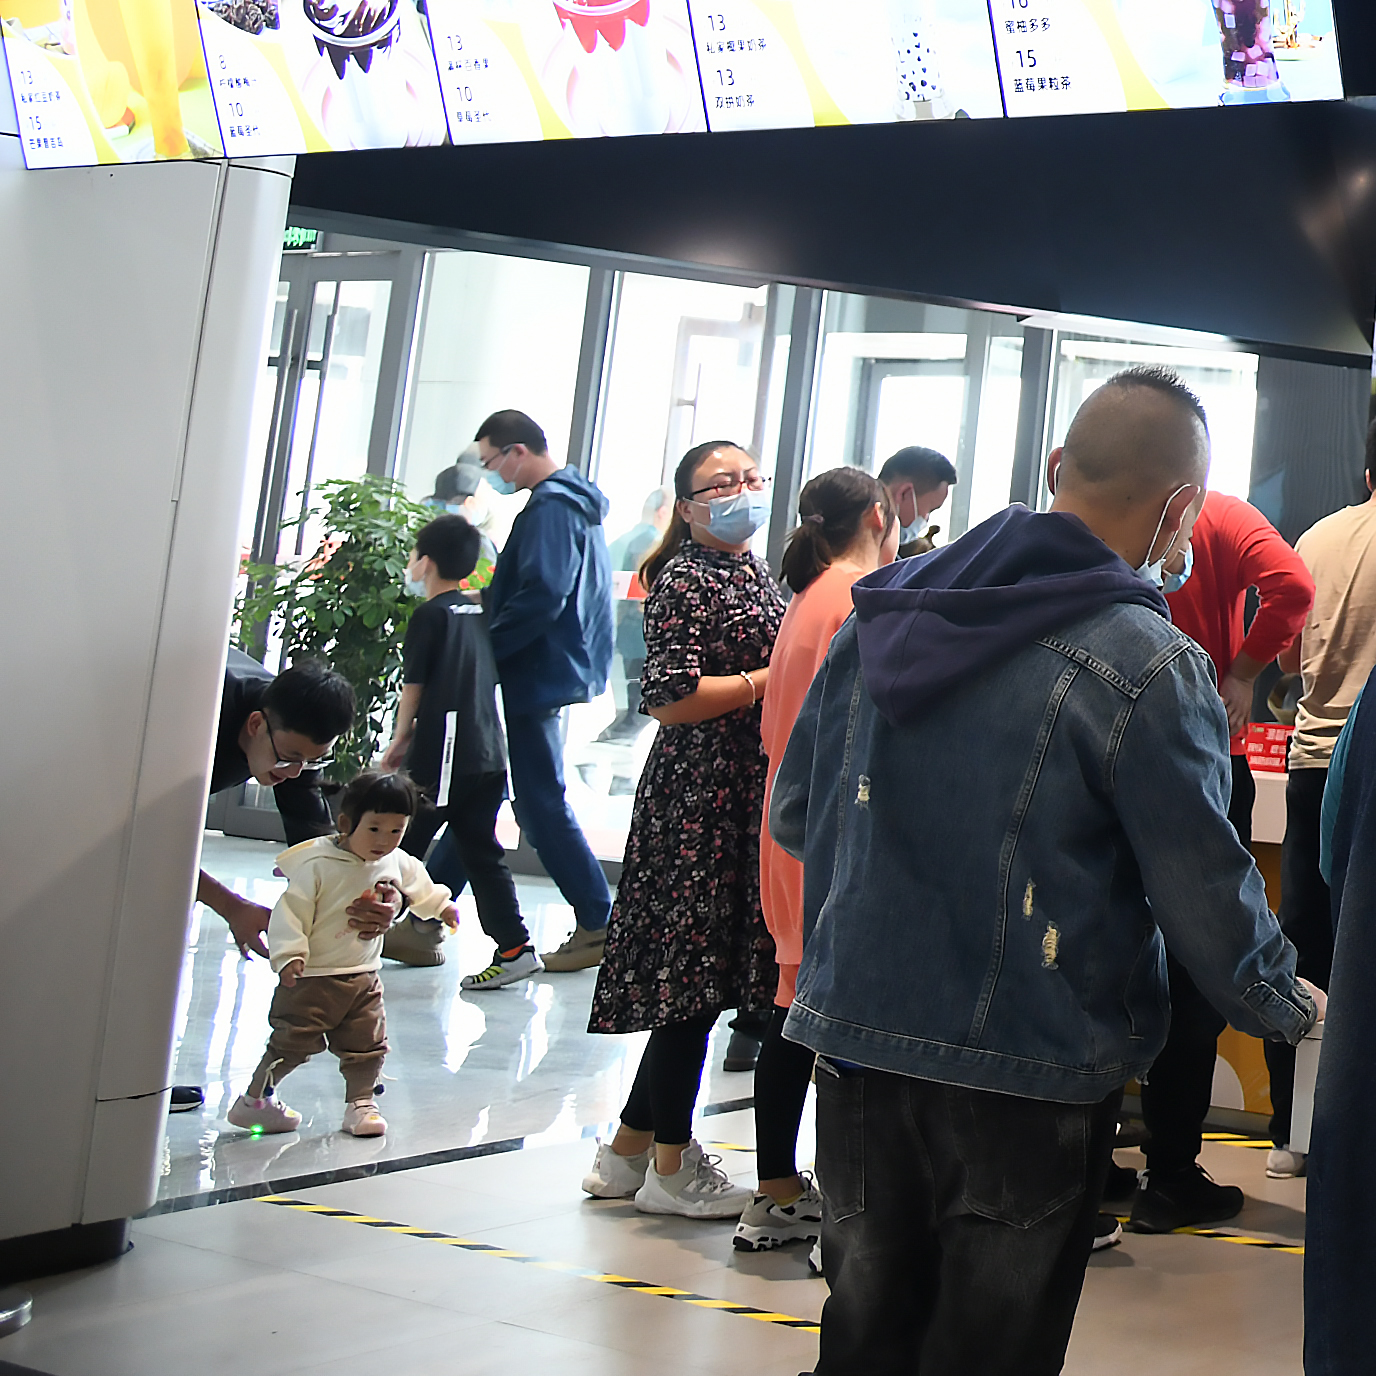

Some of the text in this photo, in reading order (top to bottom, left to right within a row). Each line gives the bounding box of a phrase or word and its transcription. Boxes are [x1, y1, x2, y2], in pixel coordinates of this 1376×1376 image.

[708, 14, 726, 31] 13
[447, 35, 463, 51] 13
[1015, 49, 1037, 68] 15
[716, 69, 735, 86] 13
[456, 86, 473, 102] 10
[228, 102, 244, 117] 10
